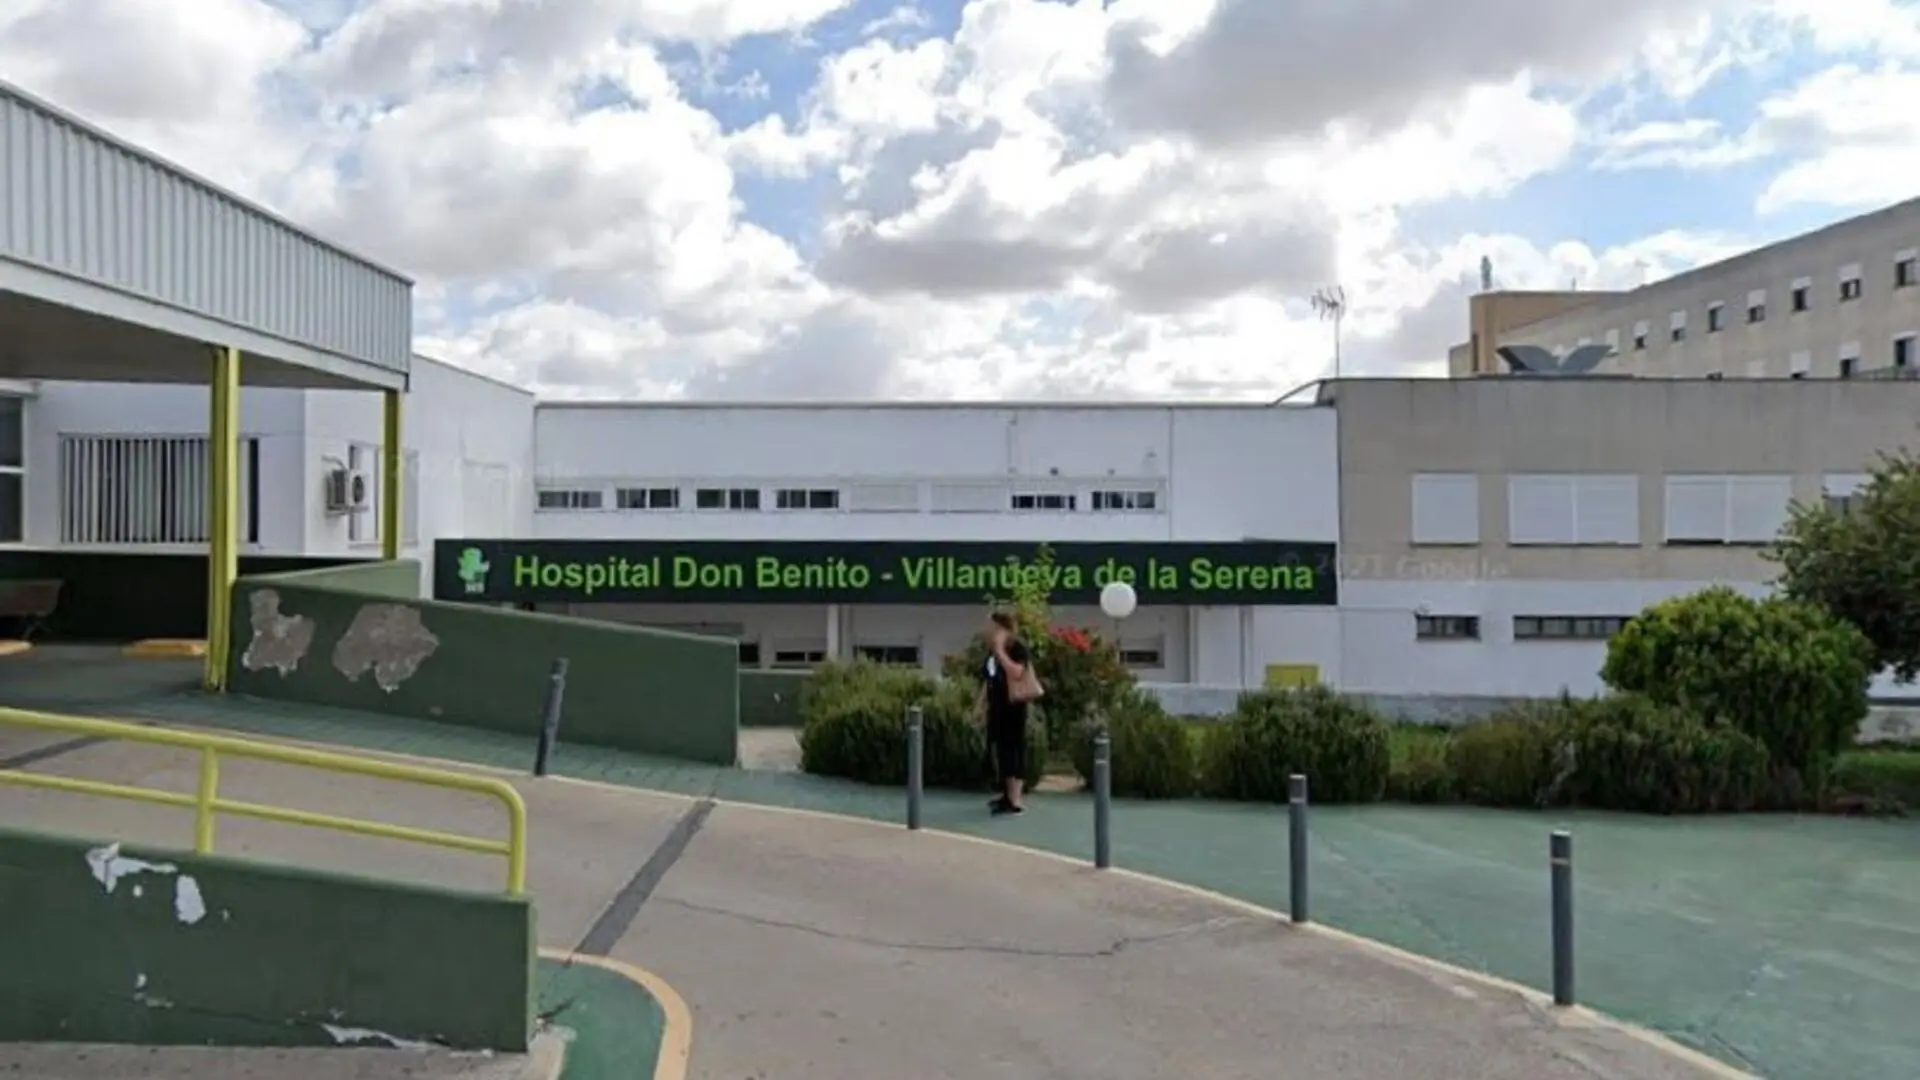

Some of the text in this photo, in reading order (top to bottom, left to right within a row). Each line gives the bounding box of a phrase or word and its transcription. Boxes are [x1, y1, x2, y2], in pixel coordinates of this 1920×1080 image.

[513, 555, 660, 594] Hospital
[673, 556, 743, 589] Don
[756, 556, 870, 589] Benito
[901, 557, 1082, 590] Villanueva
[1093, 557, 1137, 589] de
[1148, 557, 1178, 589] la
[1189, 557, 1313, 590] Serena
